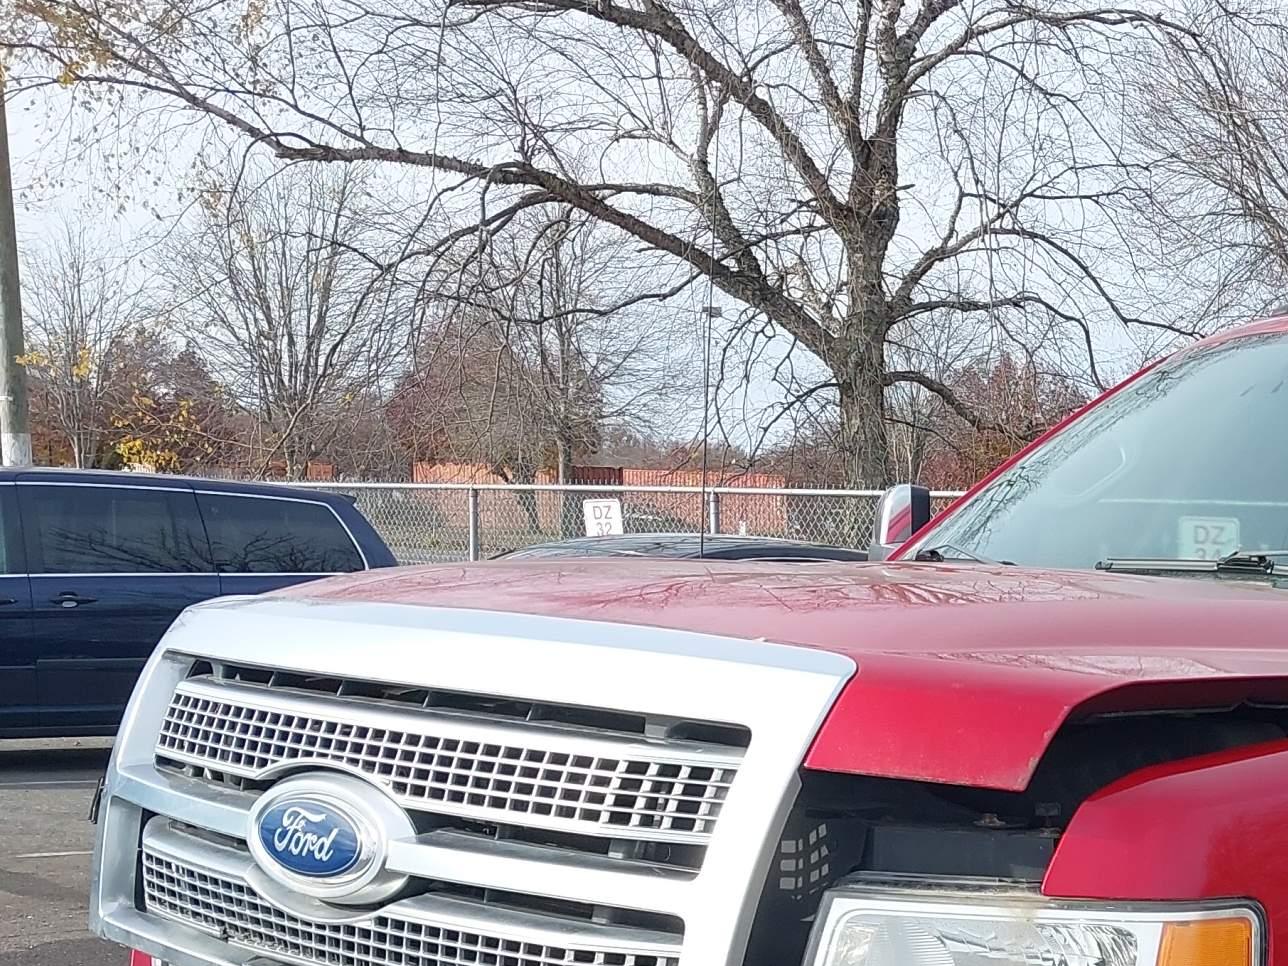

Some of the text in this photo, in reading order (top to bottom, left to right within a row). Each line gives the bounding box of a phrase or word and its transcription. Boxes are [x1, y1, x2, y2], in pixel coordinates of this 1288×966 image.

[592, 505, 613, 520] DZ
[595, 521, 613, 536] 32
[1193, 524, 1225, 546] DZ
[273, 806, 339, 862] Ford
